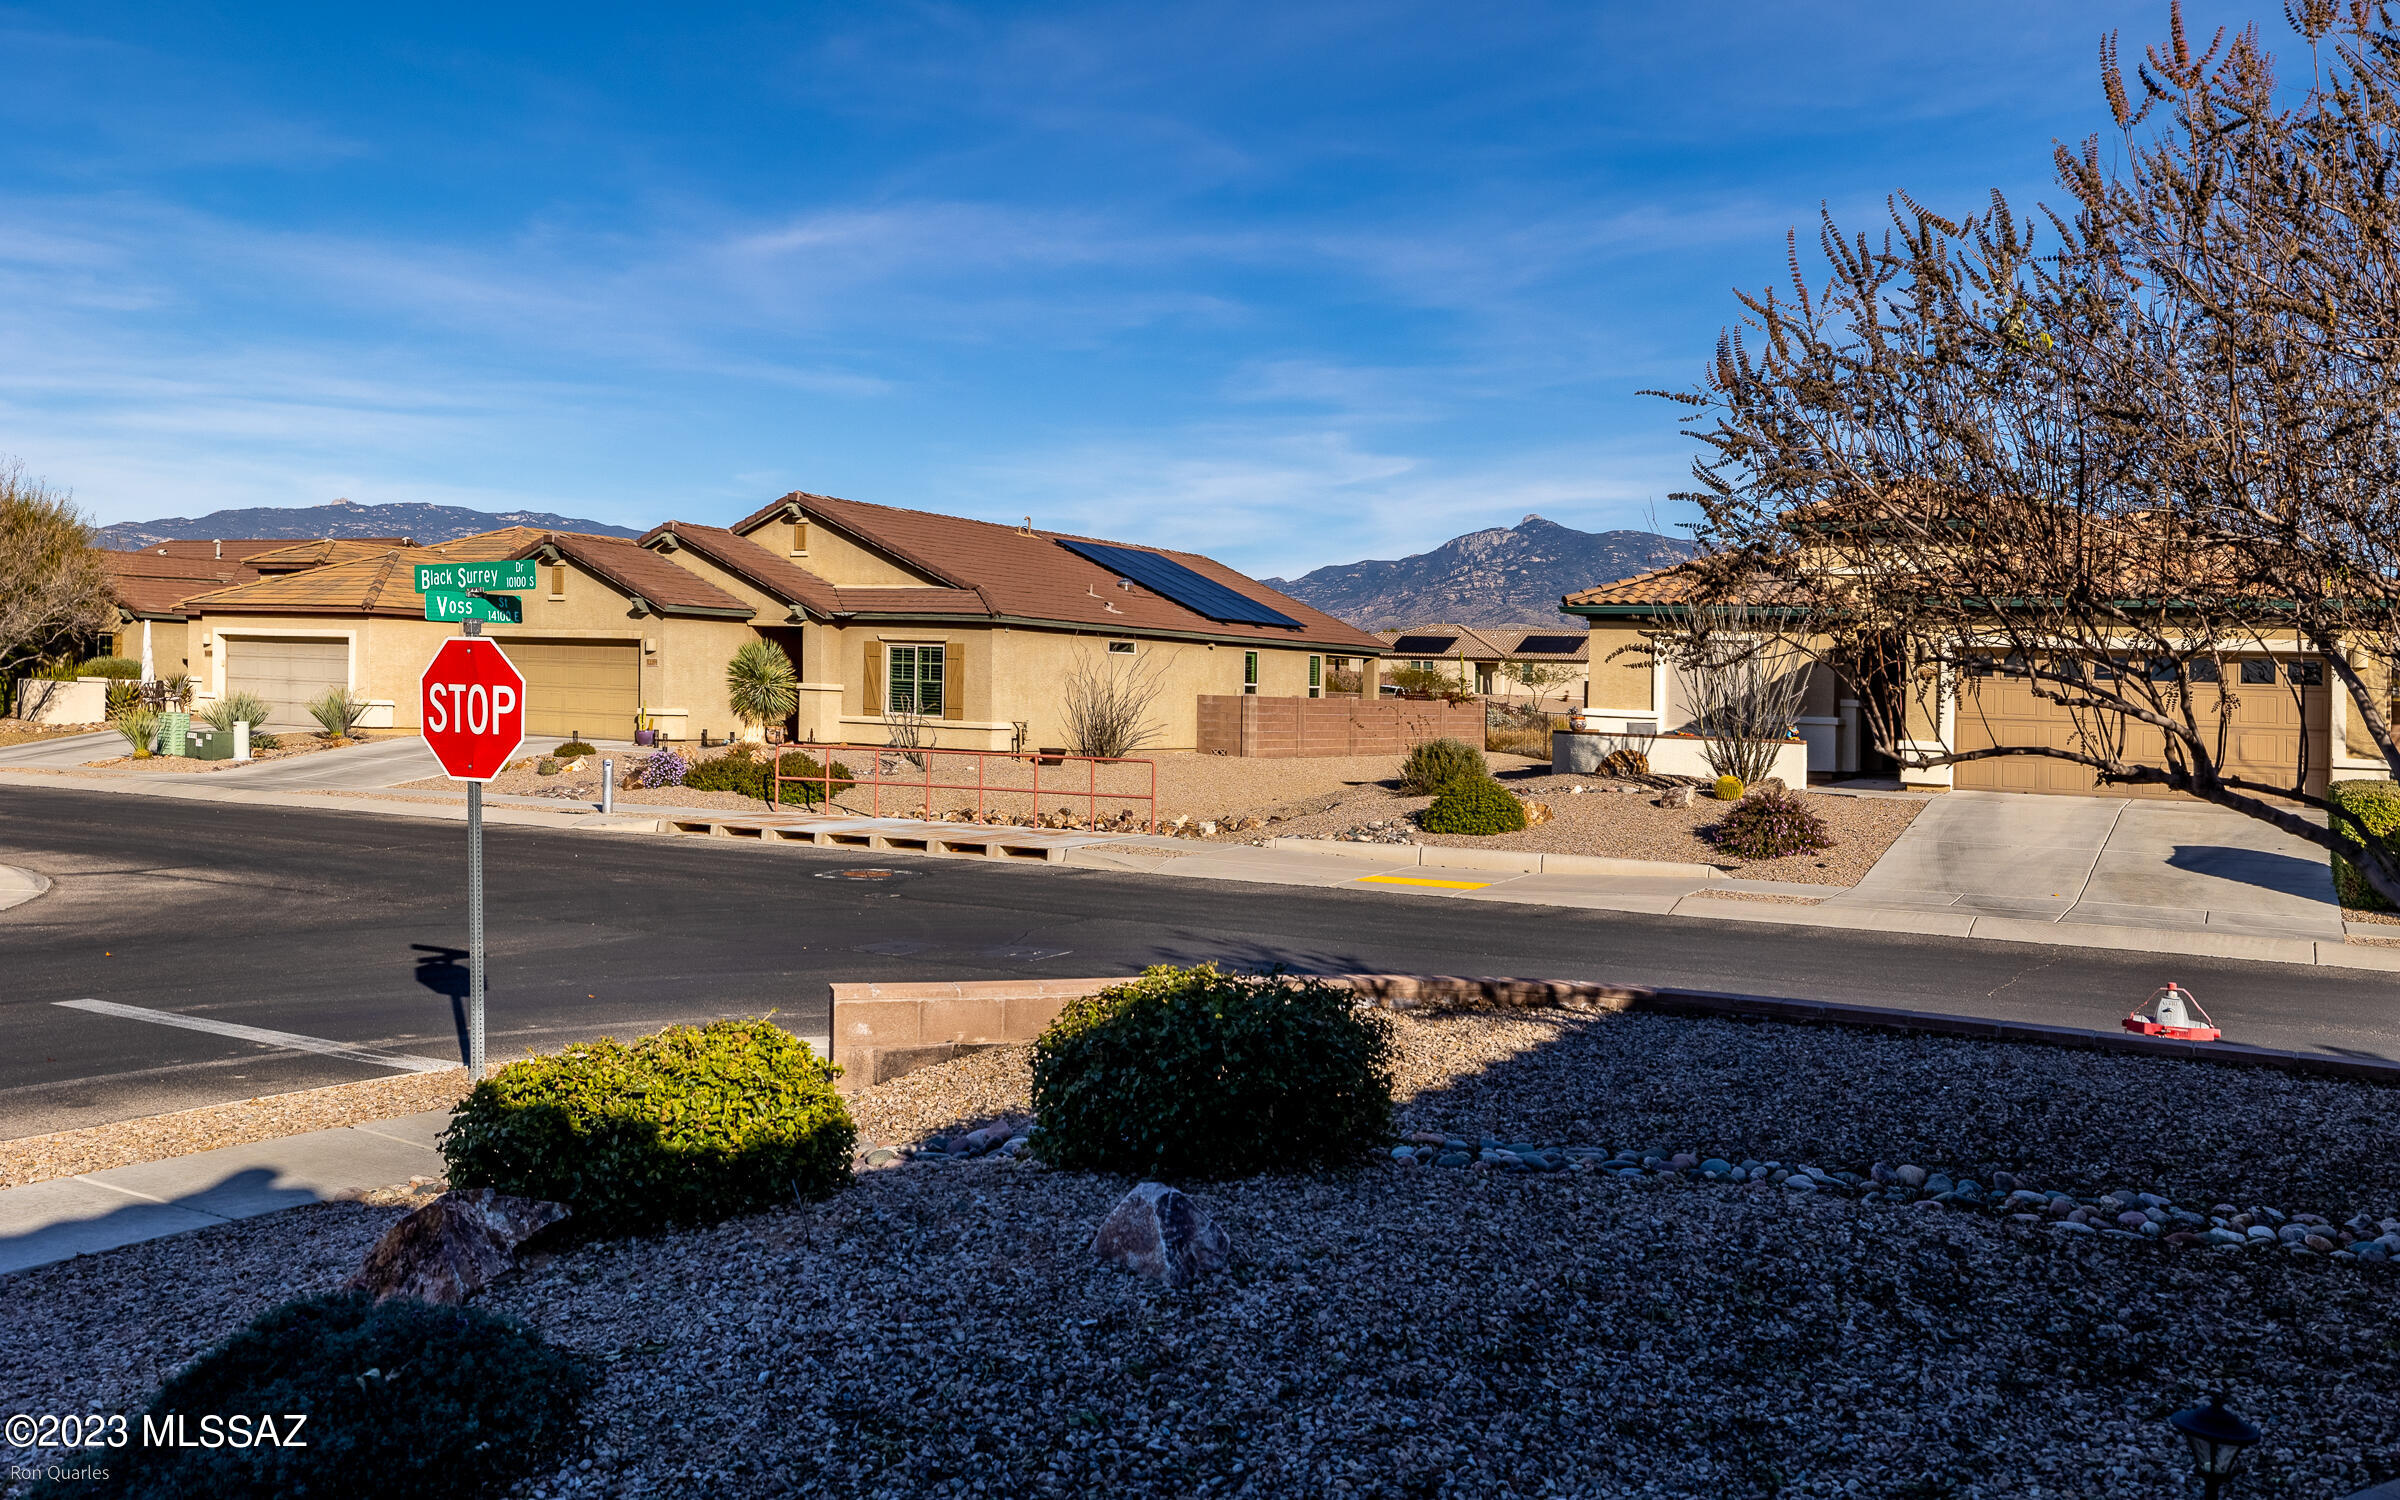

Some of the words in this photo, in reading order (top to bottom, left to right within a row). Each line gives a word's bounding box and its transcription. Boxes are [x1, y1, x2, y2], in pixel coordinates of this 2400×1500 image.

[515, 562, 524, 573] Dr
[421, 569, 453, 590] Black
[457, 567, 498, 588] Surrey
[506, 576, 527, 588] 10100
[529, 576, 535, 587] S
[436, 595, 473, 617] Voss
[498, 597, 508, 608] St
[488, 610, 511, 622] 14100
[514, 611, 520, 622] E
[428, 682, 516, 735] STOP
